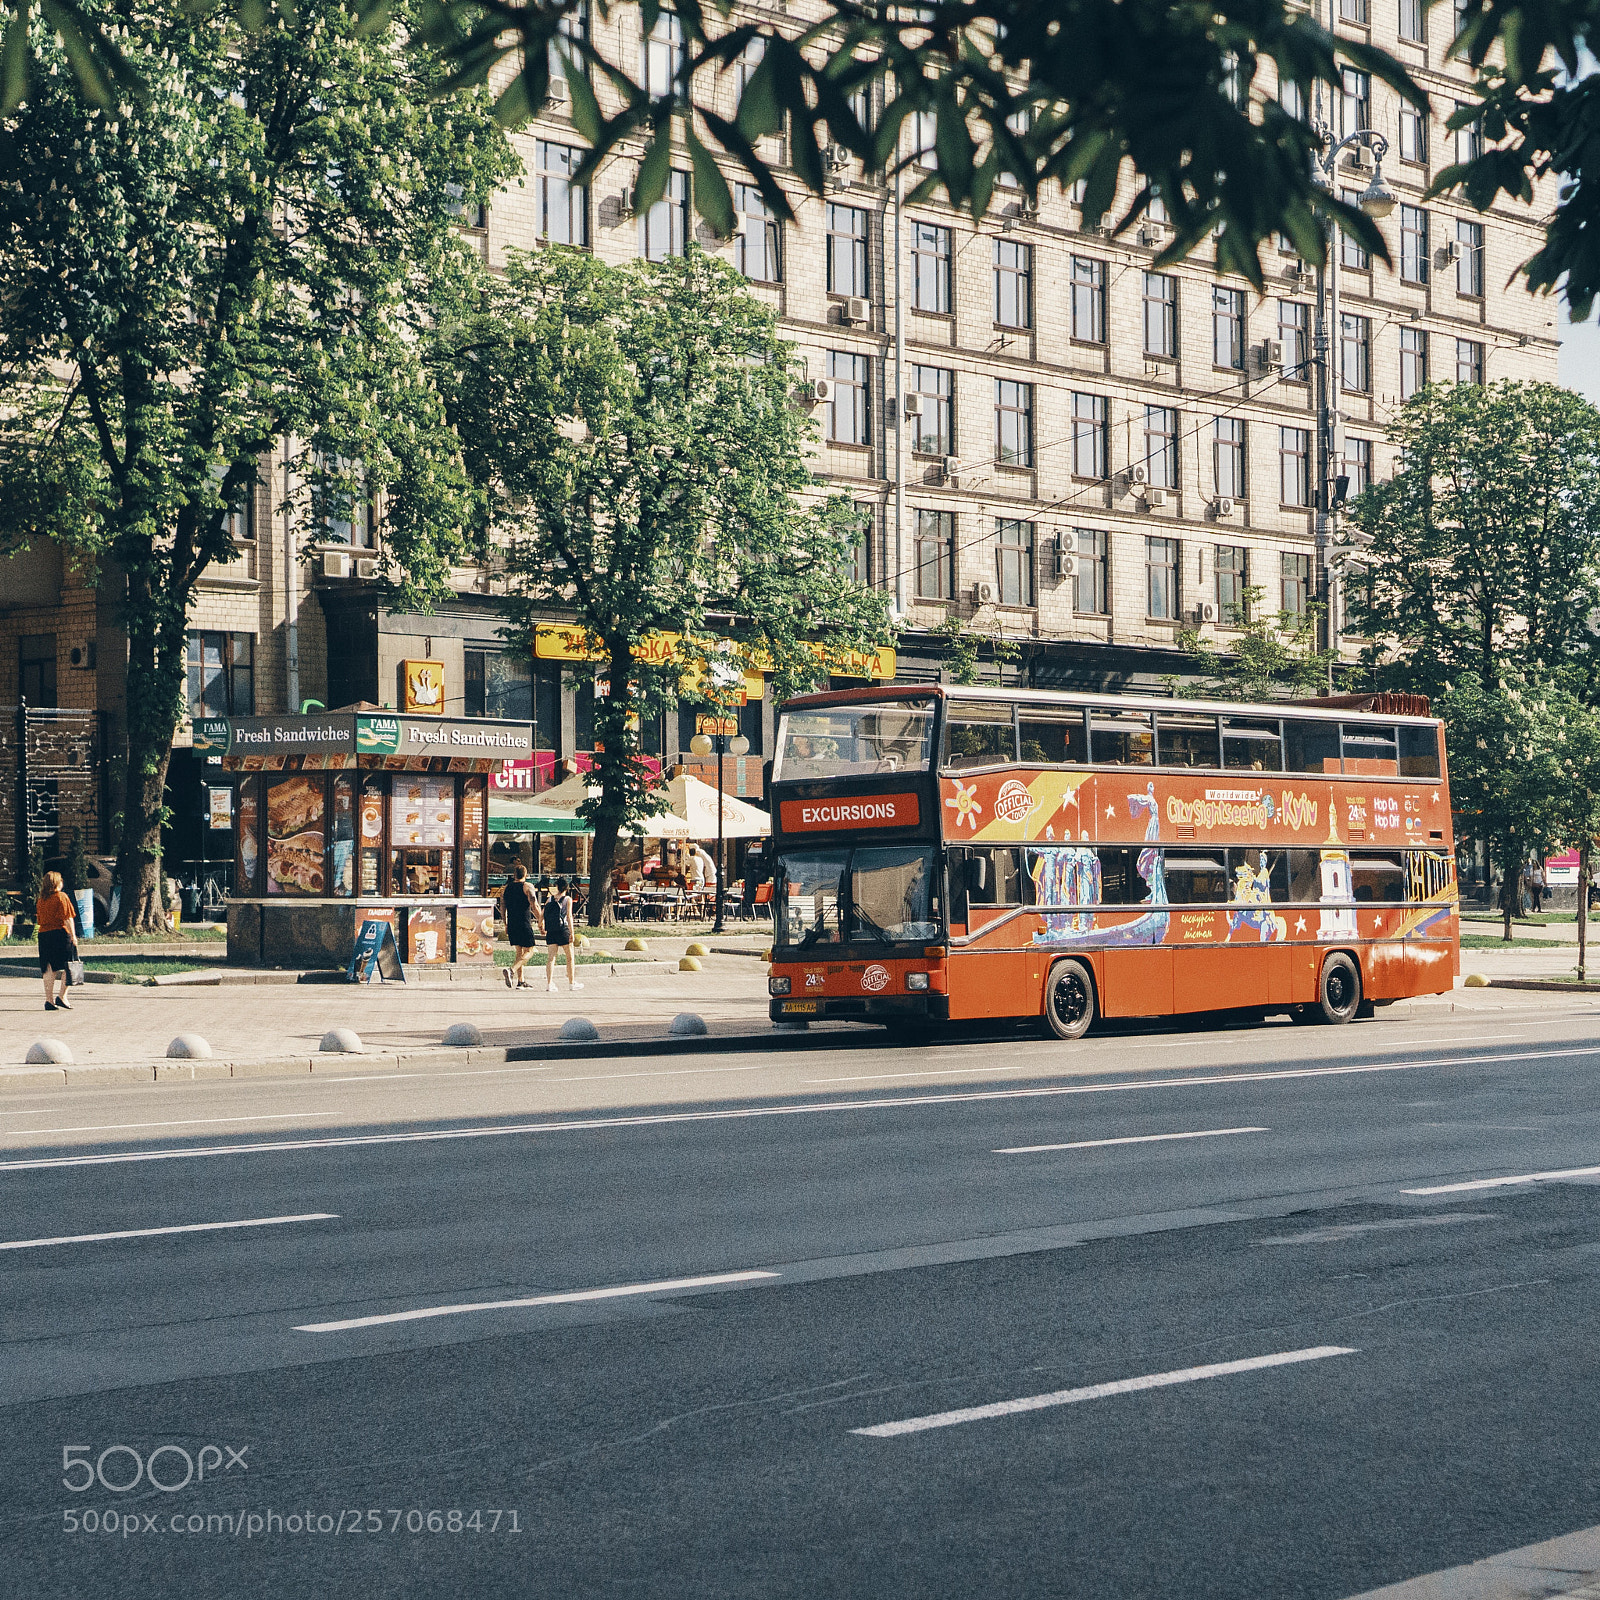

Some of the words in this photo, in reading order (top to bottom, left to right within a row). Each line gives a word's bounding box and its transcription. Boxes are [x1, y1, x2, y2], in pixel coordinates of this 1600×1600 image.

[203, 722, 227, 733] ГАМА
[370, 718, 398, 730] ГАМА
[235, 727, 272, 743] Fresh
[274, 726, 350, 742] Sandwiches
[408, 727, 449, 744] Fresh
[451, 729, 528, 748] Sandwiches
[1209, 790, 1255, 800] Worldwide
[997, 795, 1033, 816] OFFICIAL
[1281, 790, 1318, 831] Kyiv
[1373, 797, 1388, 812] Hop
[1388, 797, 1398, 811] On
[802, 802, 896, 823] EXCURSIONS
[1011, 807, 1027, 820] TOUR
[1374, 814, 1389, 829] Hop
[1389, 813, 1400, 828] Off
[862, 973, 890, 987] OFFICIAL
